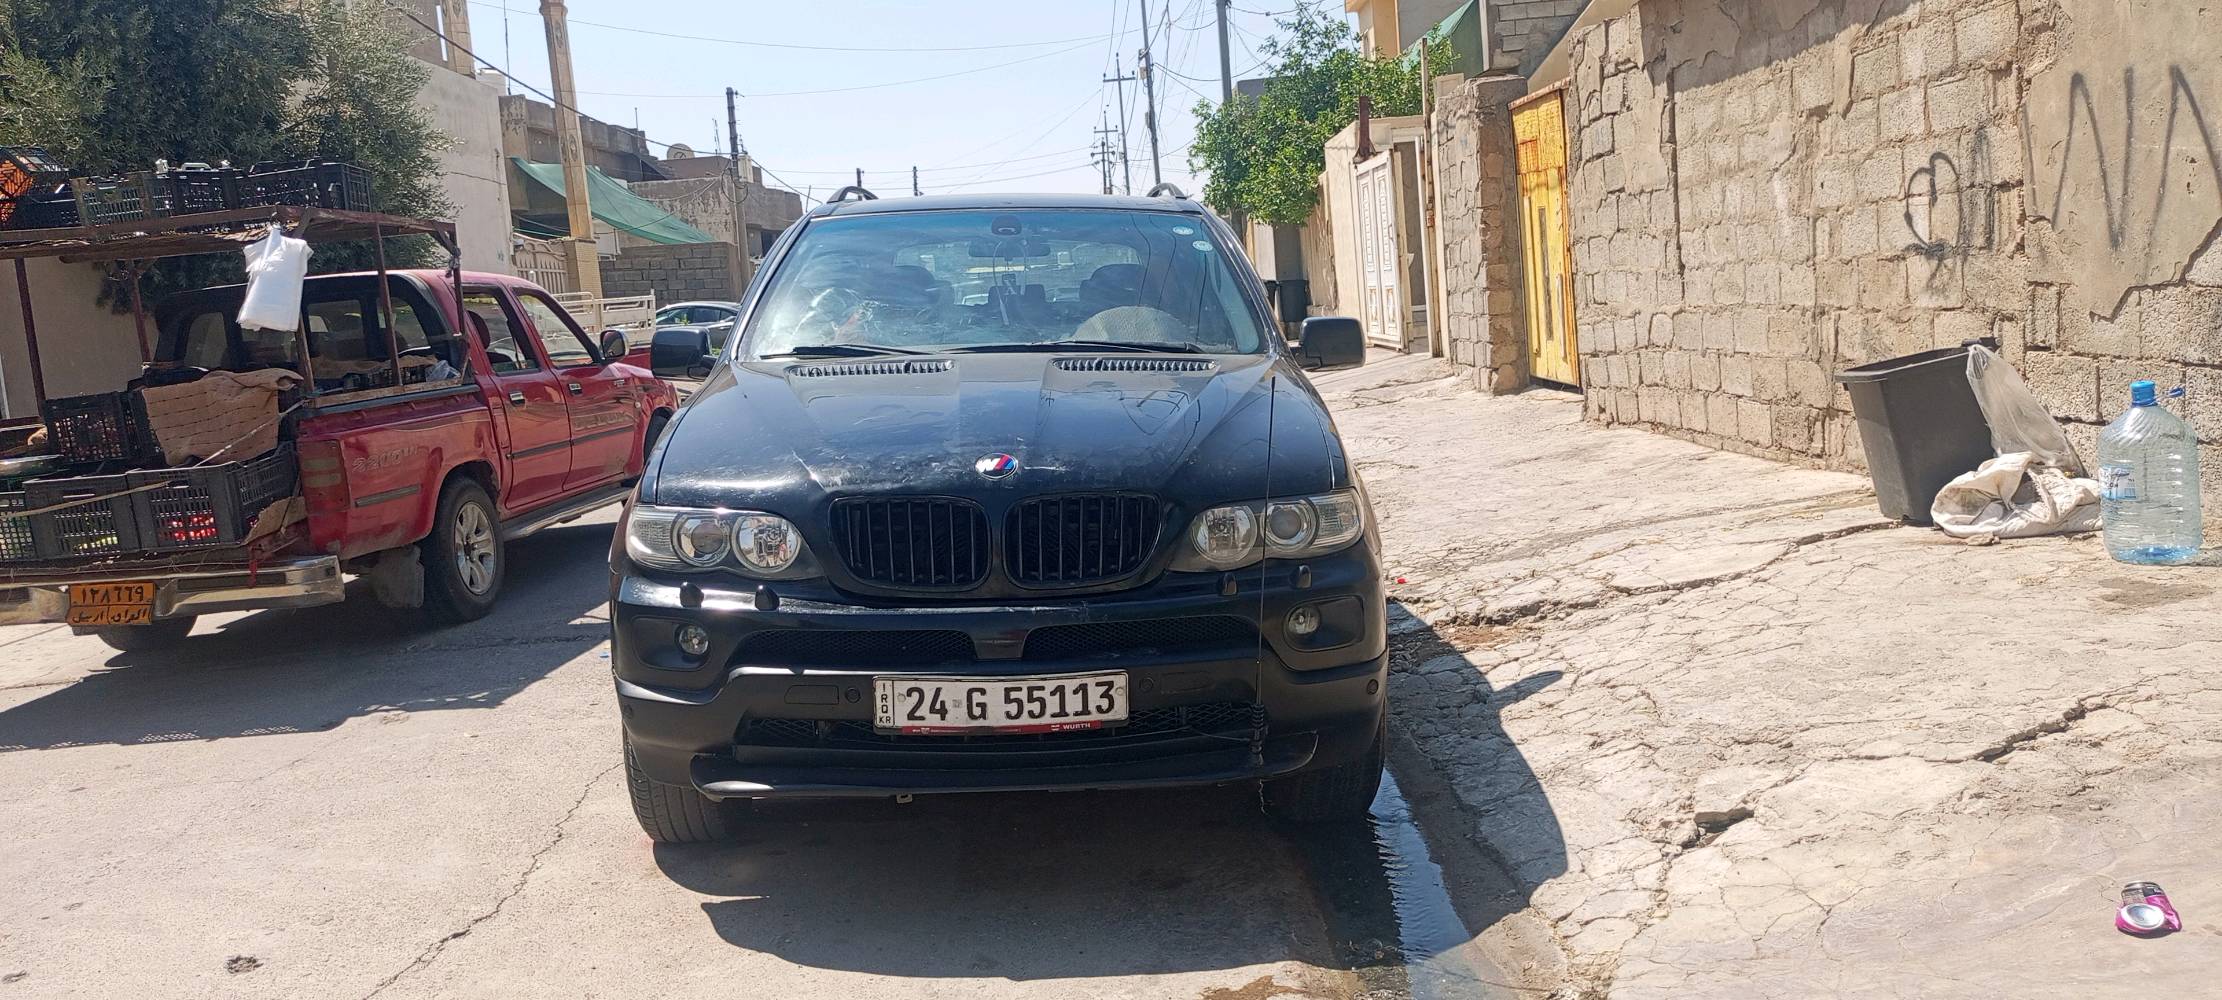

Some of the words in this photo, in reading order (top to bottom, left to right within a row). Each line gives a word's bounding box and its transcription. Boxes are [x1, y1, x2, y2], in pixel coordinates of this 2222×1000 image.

[906, 686, 948, 722] 24
[966, 687, 987, 722] G
[1003, 680, 1115, 721] 55113
